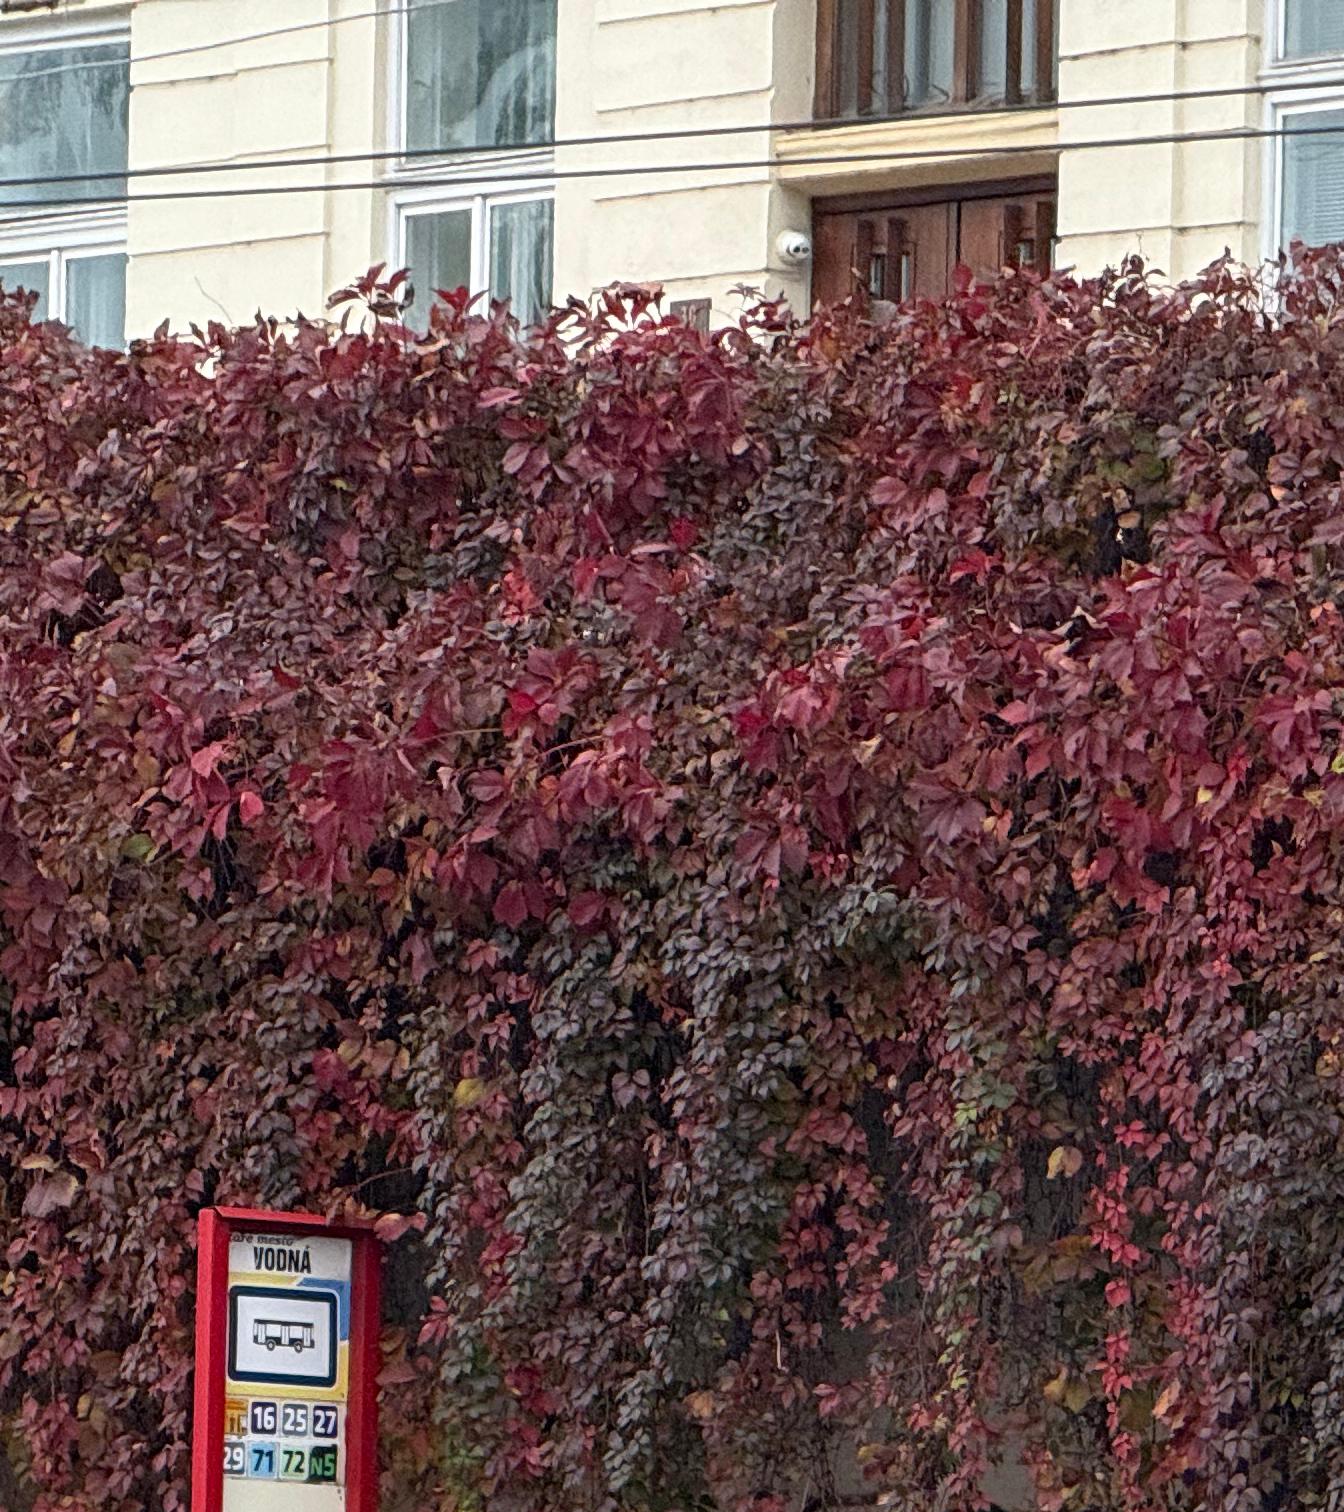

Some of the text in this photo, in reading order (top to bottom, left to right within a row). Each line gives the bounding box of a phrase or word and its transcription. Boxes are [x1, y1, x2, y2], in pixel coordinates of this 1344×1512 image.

[254, 1244, 311, 1274] VODNÁ
[253, 1406, 275, 1430] 16
[283, 1407, 307, 1433] 25
[314, 1409, 337, 1434] 27
[223, 1446, 336, 1477] 29 71 72 N5
